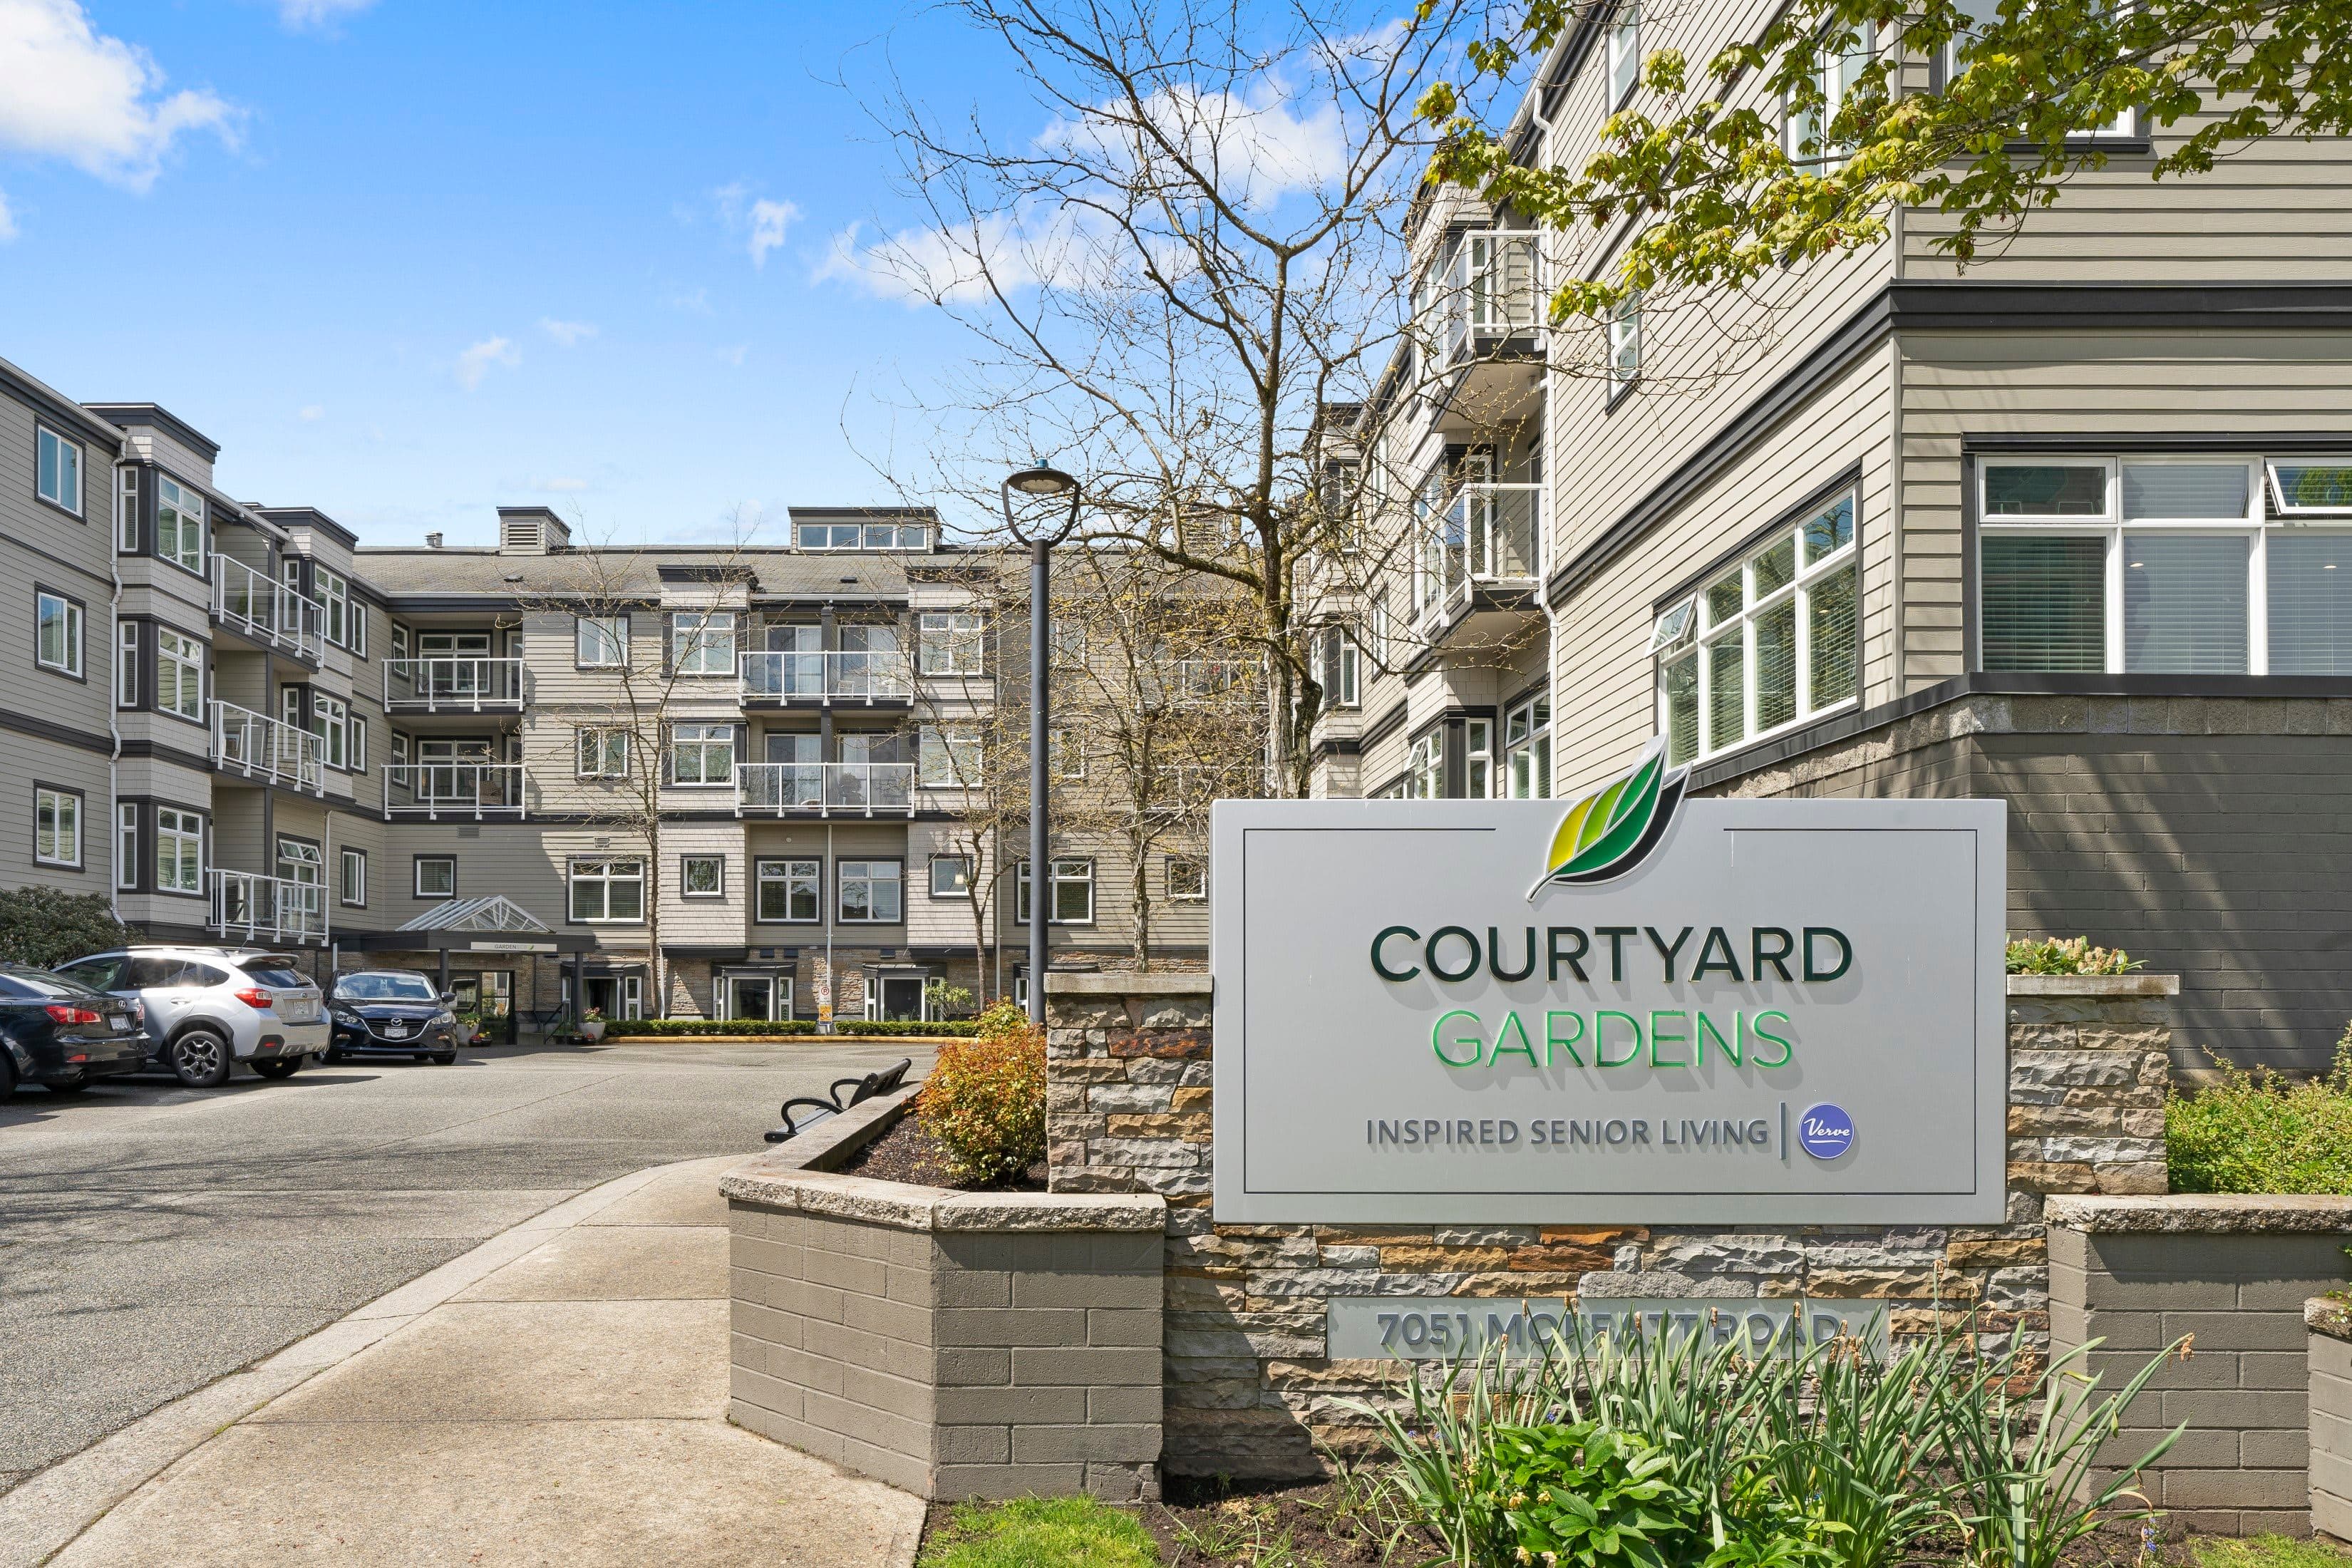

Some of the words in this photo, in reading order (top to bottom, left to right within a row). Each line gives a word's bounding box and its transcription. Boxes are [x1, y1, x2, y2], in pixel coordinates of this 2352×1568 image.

[1371, 925, 1852, 983] COURTYARD
[1431, 1009, 1793, 1068] GARDENS
[1366, 1119, 1518, 1145] INSPIRED
[1530, 1119, 1649, 1145] SENIOR
[1662, 1119, 1768, 1145] LIVING
[1803, 1118, 1850, 1137] Verve
[1377, 1313, 1468, 1345] 7051
[1712, 1313, 1840, 1345] ROAD
